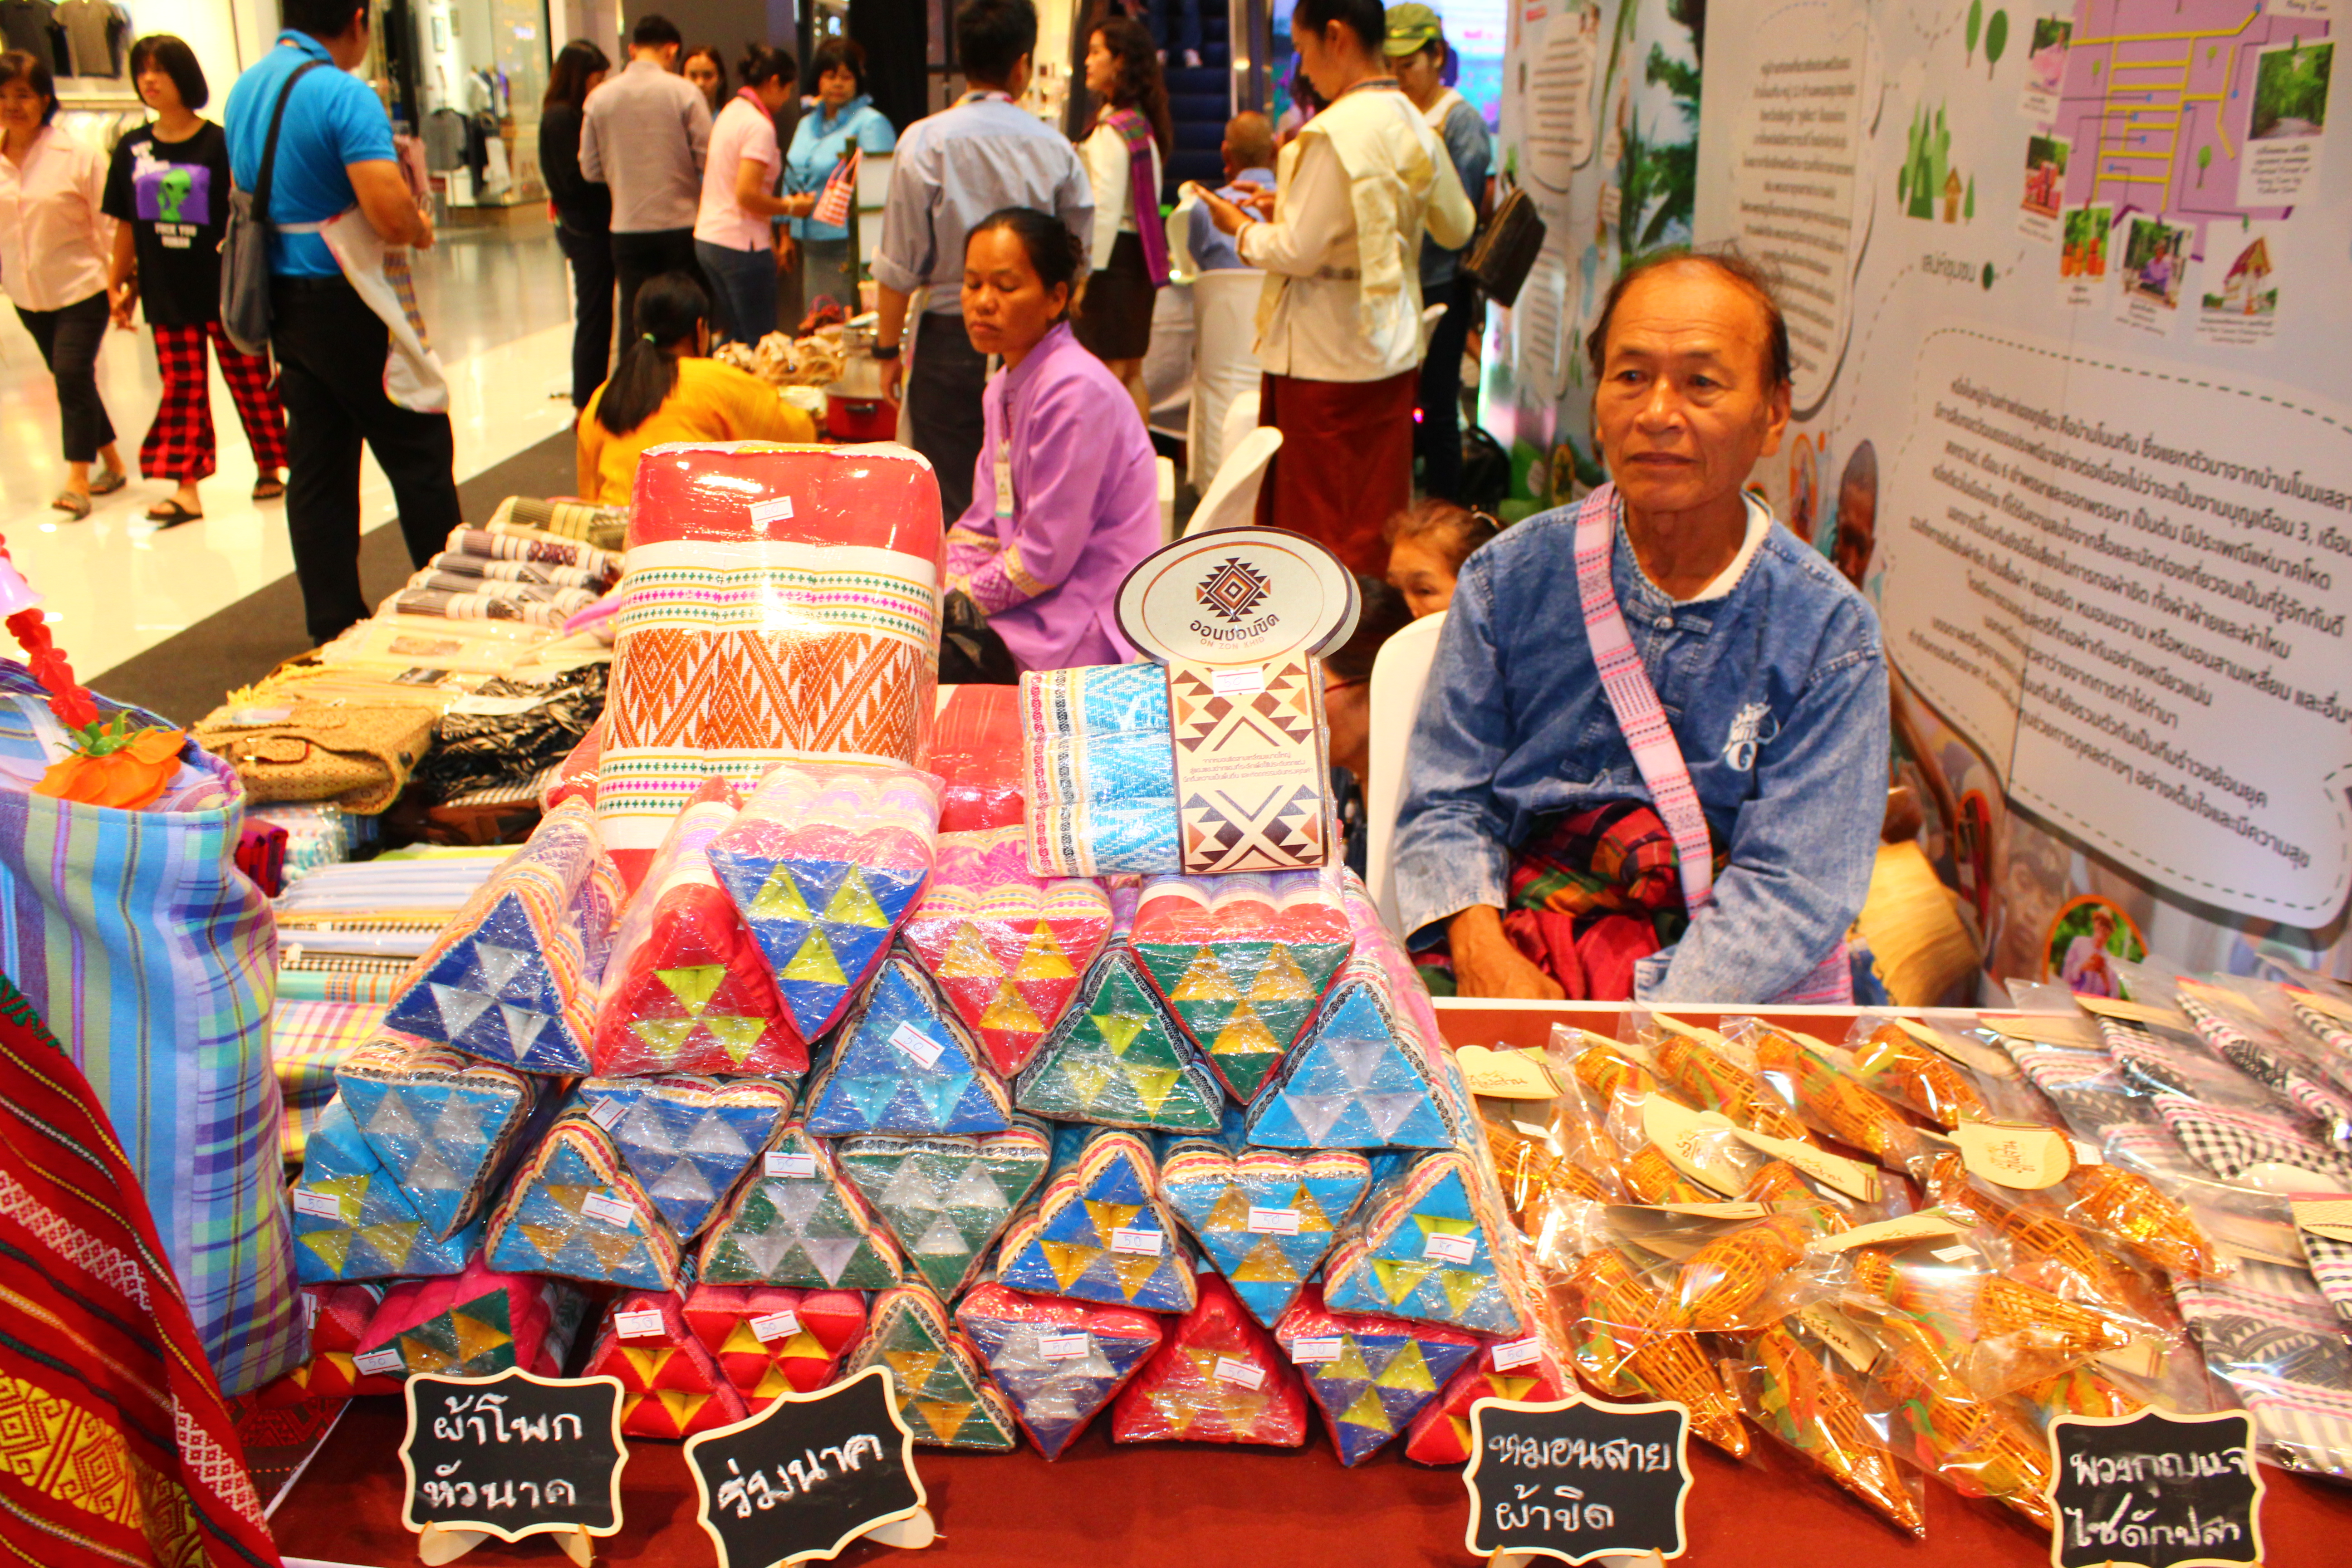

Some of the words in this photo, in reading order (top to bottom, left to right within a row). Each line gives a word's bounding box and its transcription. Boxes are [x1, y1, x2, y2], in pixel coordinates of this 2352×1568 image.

[1200, 637, 1215, 647] ON
[1218, 642, 1239, 650] ZON
[1244, 636, 1265, 648] KHID
[903, 1034, 924, 1051] 50
[776, 1157, 794, 1171] 50
[307, 1198, 323, 1210] 50
[595, 1200, 616, 1215] 50
[1263, 1214, 1280, 1227] 50
[1123, 1235, 1142, 1248] 50
[631, 1318, 652, 1330] 50
[761, 1323, 777, 1334] 50
[1053, 1343, 1071, 1355] 50
[1308, 1343, 1326, 1355] 50
[1507, 1347, 1524, 1360] 50
[368, 1357, 386, 1367] 50
[1227, 1367, 1245, 1379] 50
[434, 1392, 583, 1446] ผ้าโพก
[1488, 1433, 1671, 1473] หมอนสาย
[423, 1459, 576, 1510] หัวนาค
[1494, 1484, 1614, 1532] ผ้าขิด
